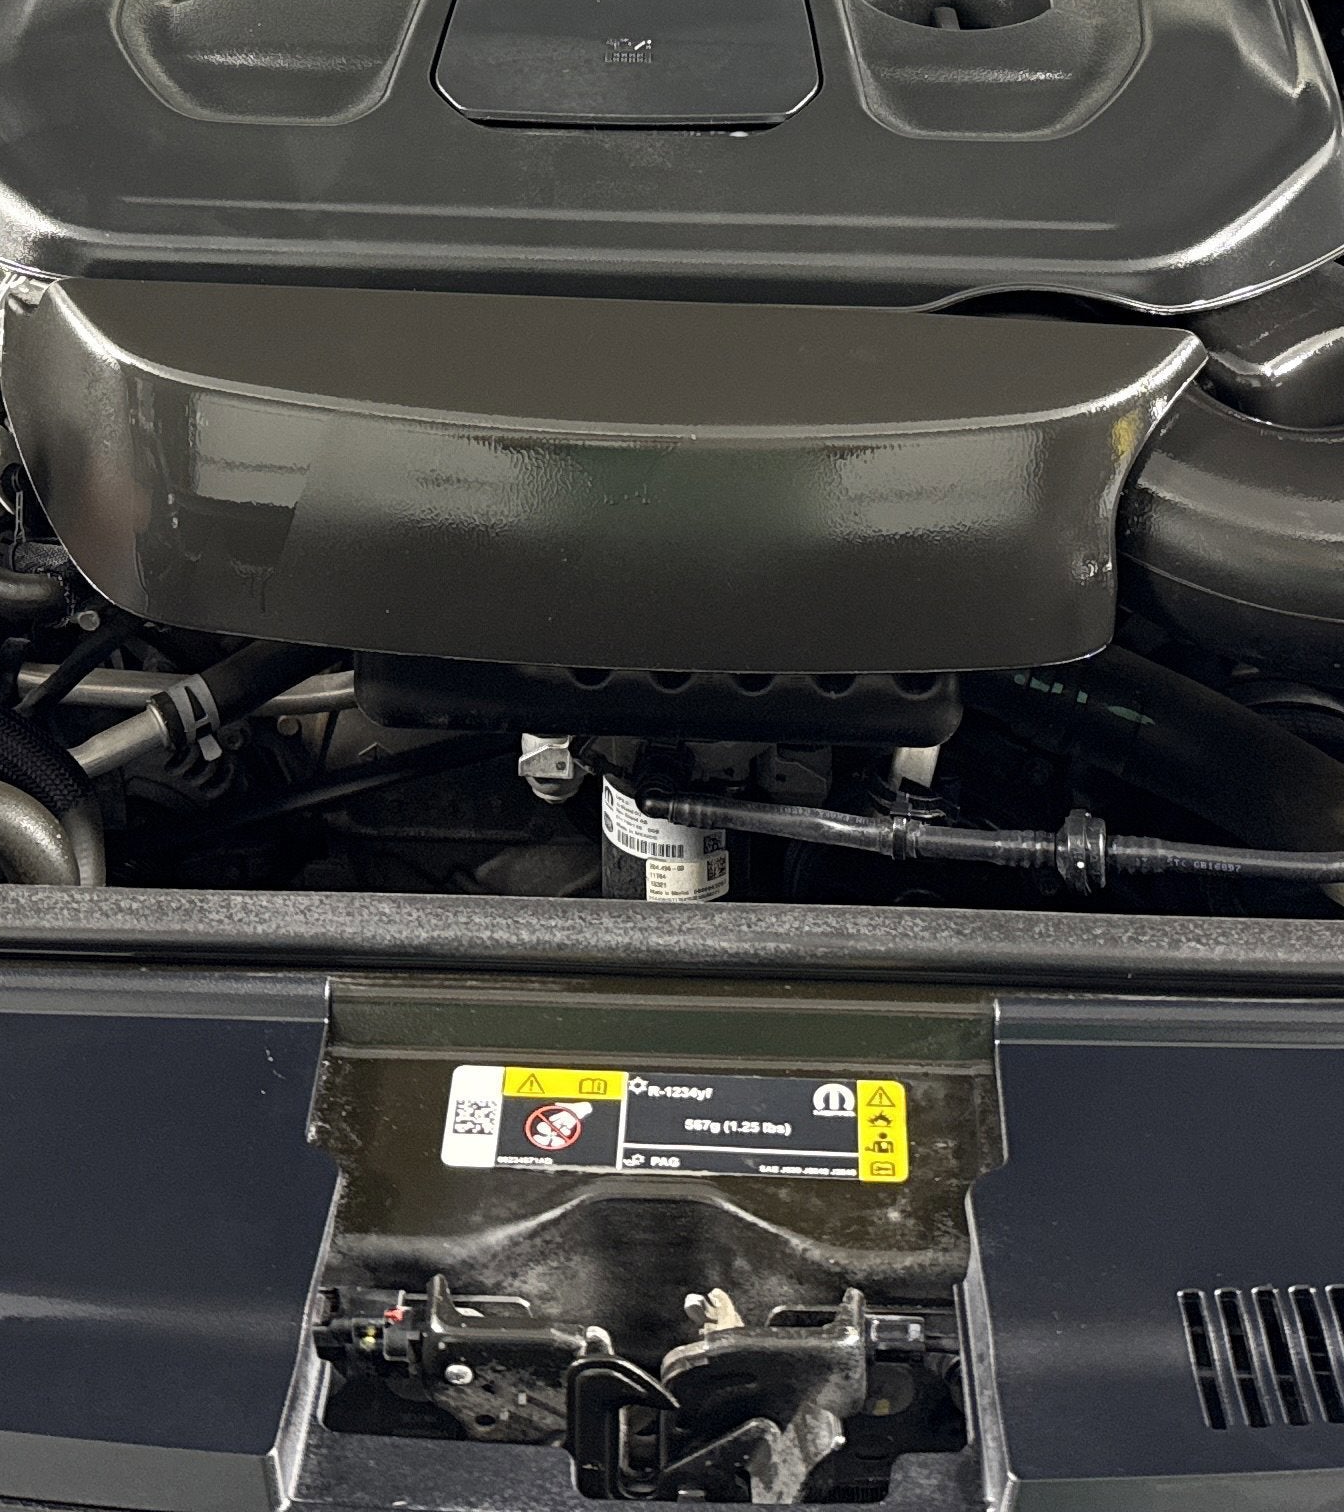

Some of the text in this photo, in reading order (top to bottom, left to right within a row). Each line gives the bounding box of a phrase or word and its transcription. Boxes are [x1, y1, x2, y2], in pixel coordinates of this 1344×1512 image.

[648, 1085, 713, 1101] R-1234yf
[723, 1120, 760, 1134] (1.25
[762, 1121, 792, 1137] lbs)
[650, 1156, 680, 1167] PAG
